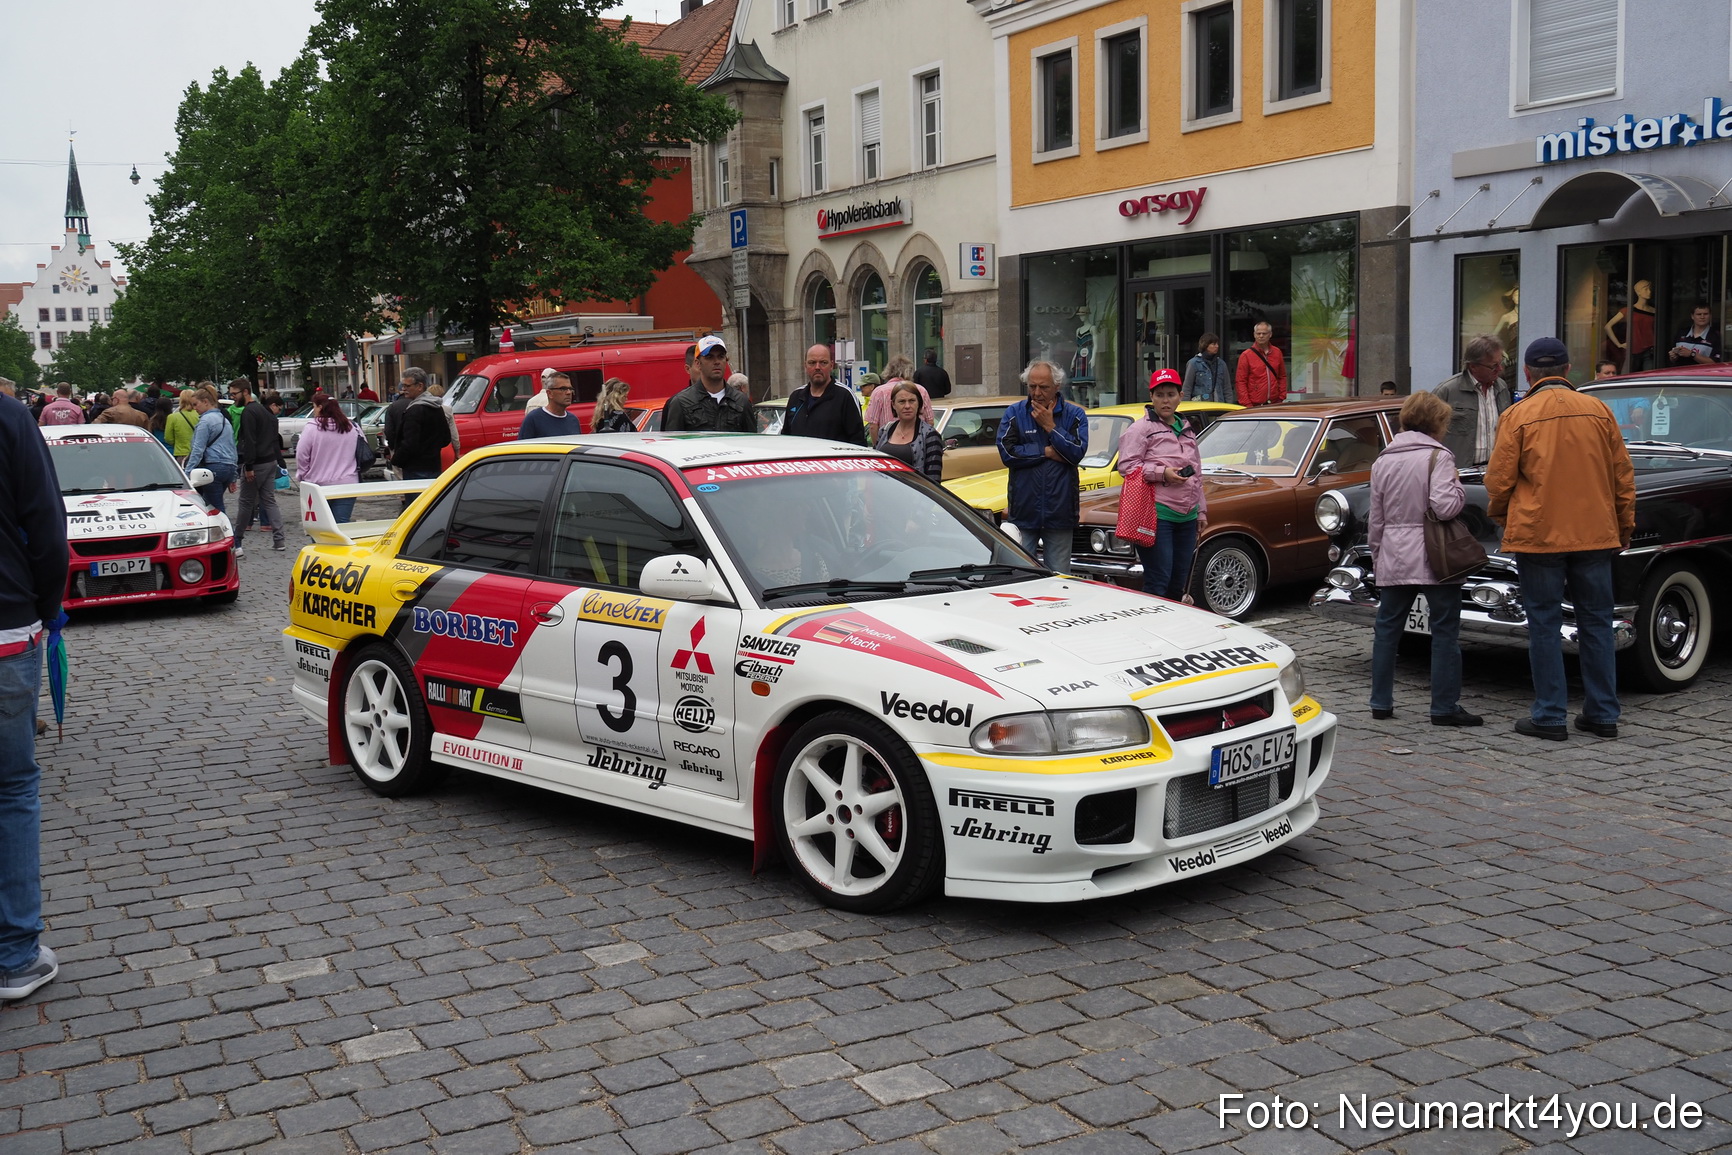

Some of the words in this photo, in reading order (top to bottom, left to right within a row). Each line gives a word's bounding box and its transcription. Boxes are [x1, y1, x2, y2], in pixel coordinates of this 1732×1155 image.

[1536, 114, 1687, 163] mister
[827, 196, 902, 232] HypoVereinsbank
[1119, 187, 1207, 225] orsay
[734, 215, 743, 244] P
[723, 461, 829, 478] MITSUBISHI
[823, 459, 887, 471] MOTORS
[70, 512, 155, 524] MICHELIN
[102, 561, 118, 574] FO
[128, 560, 135, 572] P
[138, 559, 146, 571] 7
[300, 555, 371, 596] Veedol
[392, 562, 430, 574] RECARO
[303, 591, 376, 629] KÄRCHER
[1018, 613, 1117, 636] AUTOHAUS
[1112, 604, 1176, 619] MACHT
[413, 606, 518, 648] BORBET
[862, 627, 897, 641] Macht
[295, 639, 331, 661] PIRELLI
[740, 635, 801, 657] SANDTLER
[845, 635, 880, 651] Macht
[1256, 641, 1282, 652] PIAA
[297, 657, 331, 682] Sebring
[676, 671, 709, 684] MITSUBISHI
[736, 659, 784, 678] Eibach
[746, 672, 779, 683] FEDERN
[1125, 646, 1269, 687] KÄRCHER
[428, 681, 446, 702] RALLI
[458, 688, 472, 708] ART
[597, 640, 636, 733] 3
[681, 682, 704, 694] MOTORS
[1047, 680, 1099, 696] PIAA
[486, 702, 509, 715] Germany
[676, 706, 715, 726] HELLA
[881, 691, 974, 729] Veedol
[442, 741, 509, 769] EVOLUTION
[511, 755, 523, 771] III
[673, 740, 720, 759] RECARO
[1100, 751, 1156, 765] KÄRCHER
[1262, 736, 1283, 766] EV
[1284, 733, 1293, 760] 3
[587, 747, 667, 790] Sebring
[679, 759, 725, 782] Sebring
[949, 788, 1054, 816] PIRELLI
[950, 817, 1052, 854] Sebring
[1261, 819, 1293, 844] Veedol
[1168, 849, 1216, 873] Veedol
